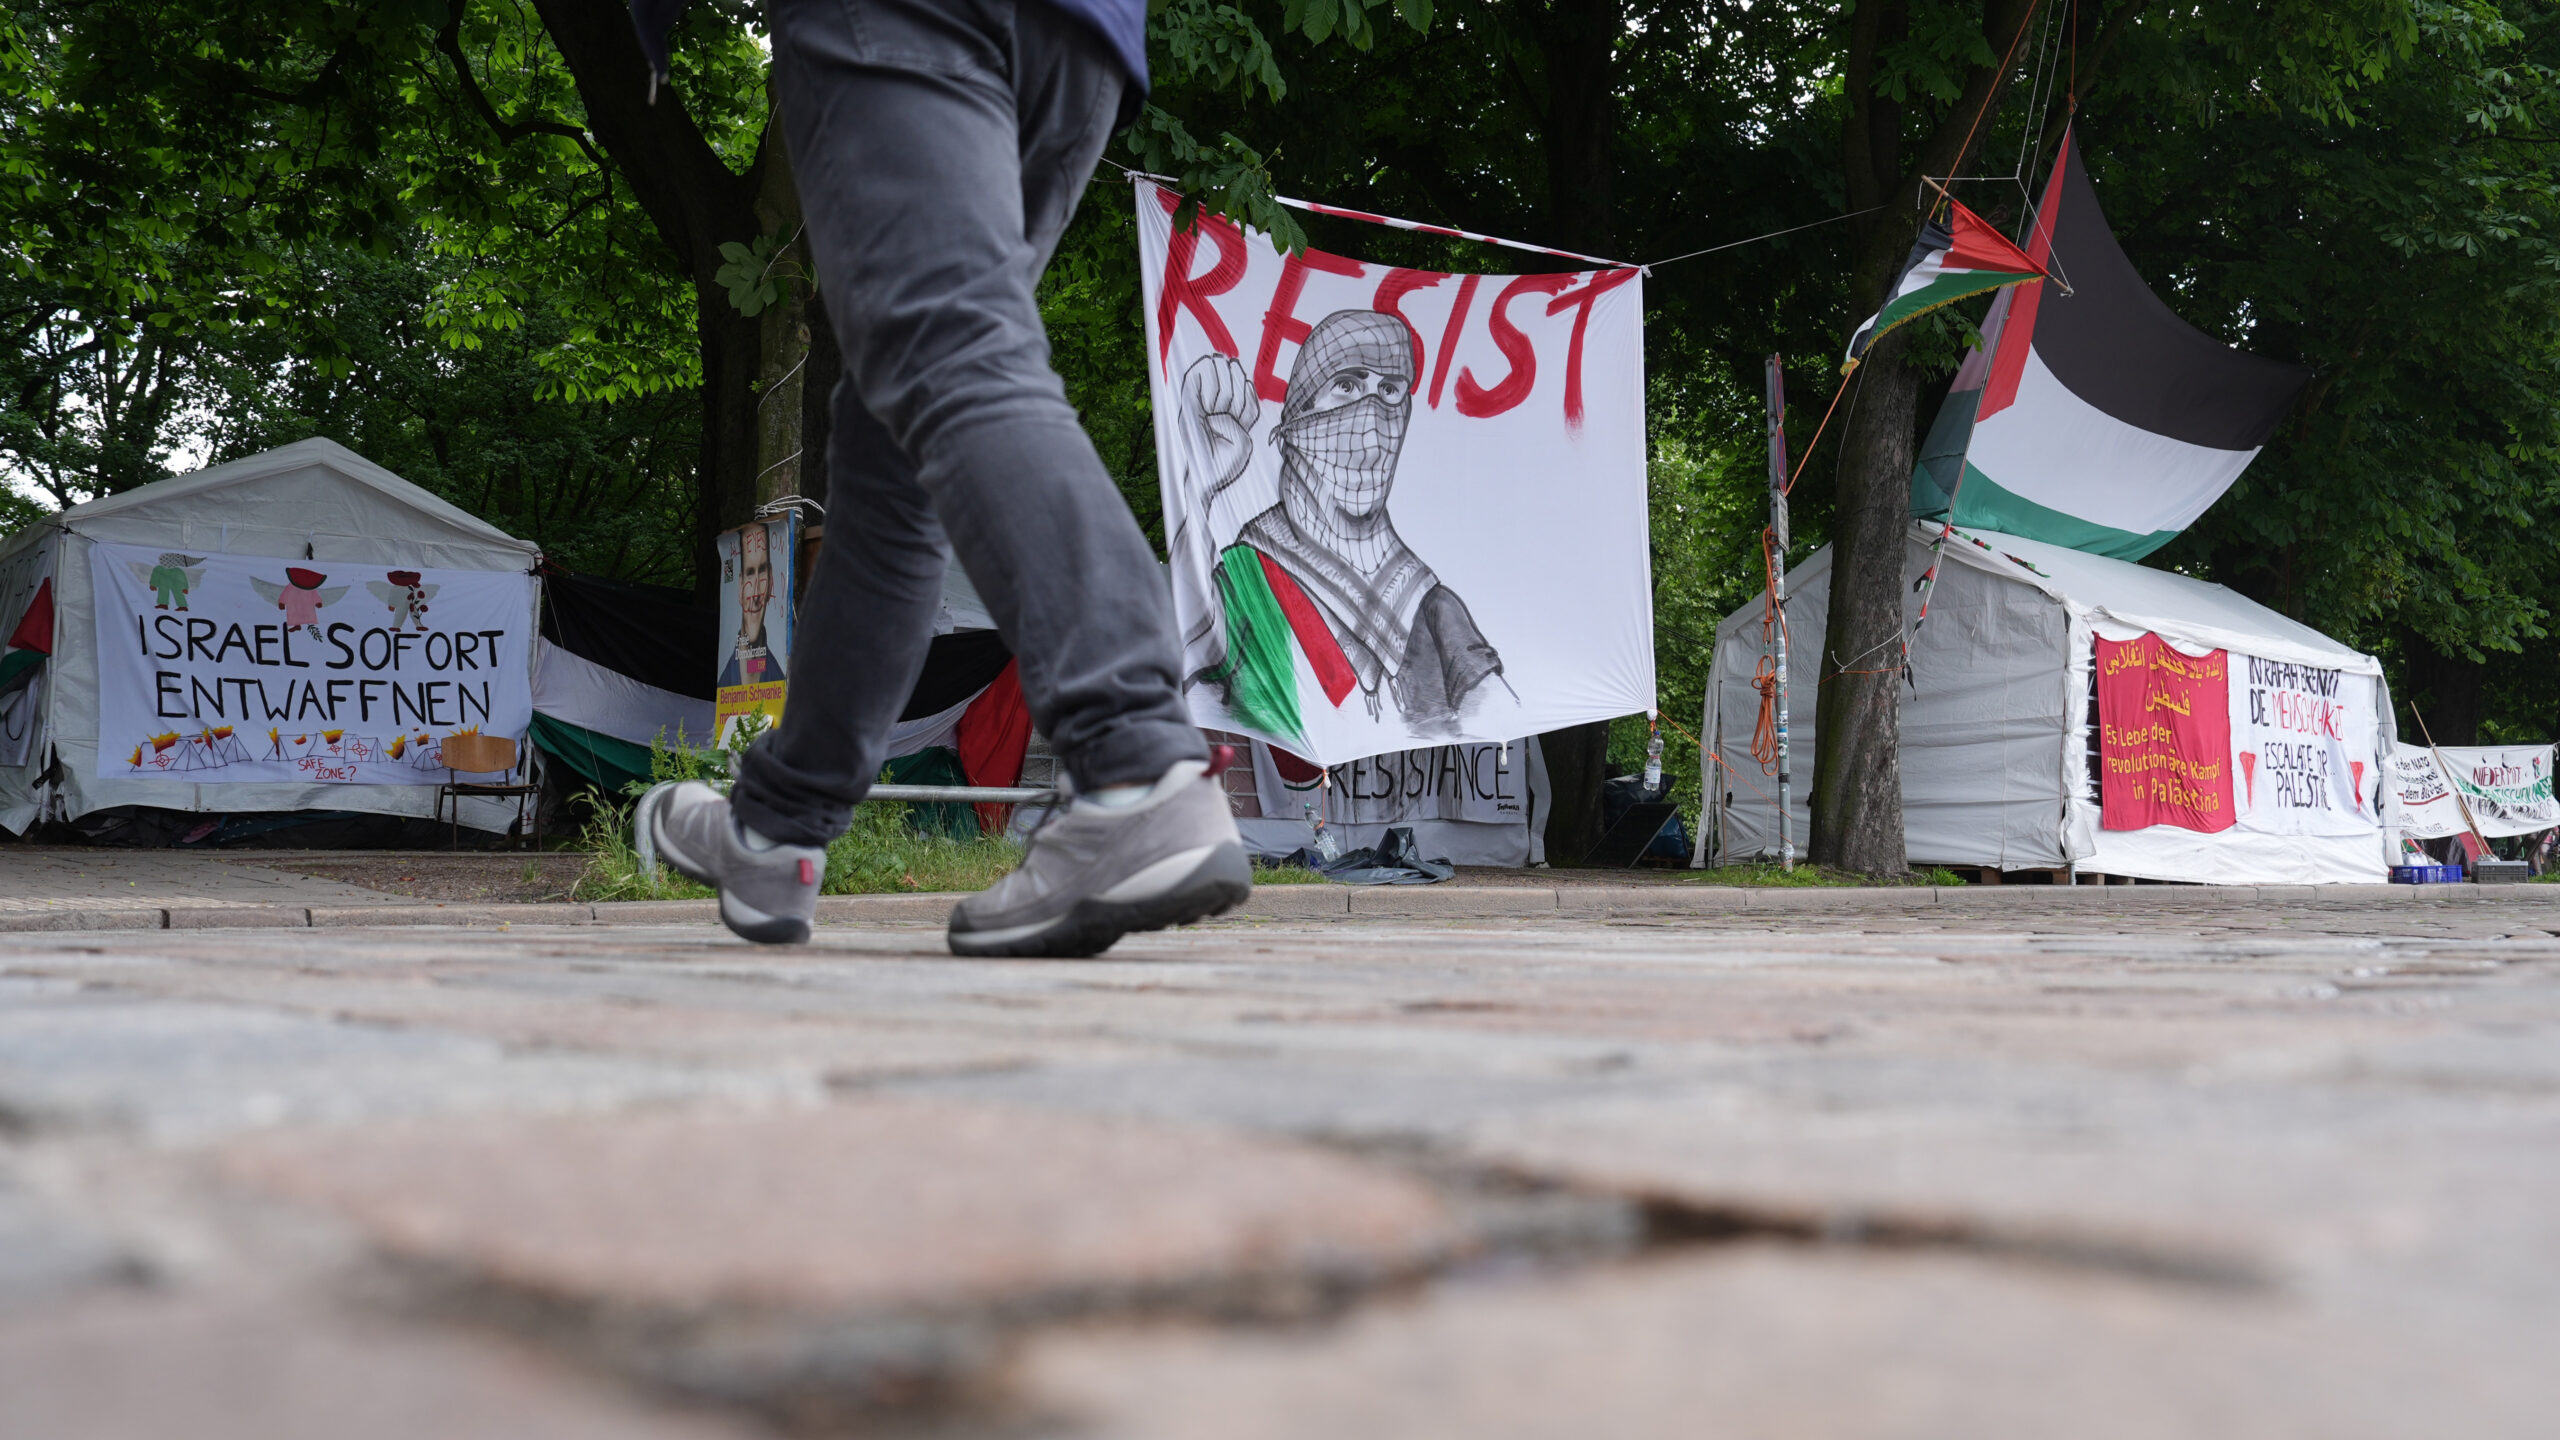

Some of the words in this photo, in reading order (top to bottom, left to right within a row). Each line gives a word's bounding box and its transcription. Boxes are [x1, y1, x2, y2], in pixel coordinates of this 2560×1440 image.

[1156, 185, 1639, 440] RESIST
[771, 531, 785, 556] ON
[139, 614, 310, 668] ISRAEL
[325, 622, 504, 671] SOFORT
[2248, 654, 2262, 685] IN
[2263, 658, 2299, 690] RAFAH
[156, 671, 490, 726] ENTWAFFNEN
[720, 687, 748, 707] Benjamin
[749, 684, 782, 702] Schwanke
[2105, 724, 2118, 746] Es
[2119, 727, 2149, 747] Lebe
[2151, 721, 2172, 745] der
[298, 758, 325, 771] SAFE
[2107, 747, 2188, 777] revolutionäre
[2190, 756, 2221, 784] Kampf
[2264, 741, 2314, 772] ESCALATE
[2473, 766, 2505, 787] NIEDER
[2132, 779, 2145, 801] in
[2151, 777, 2221, 813] Palästina
